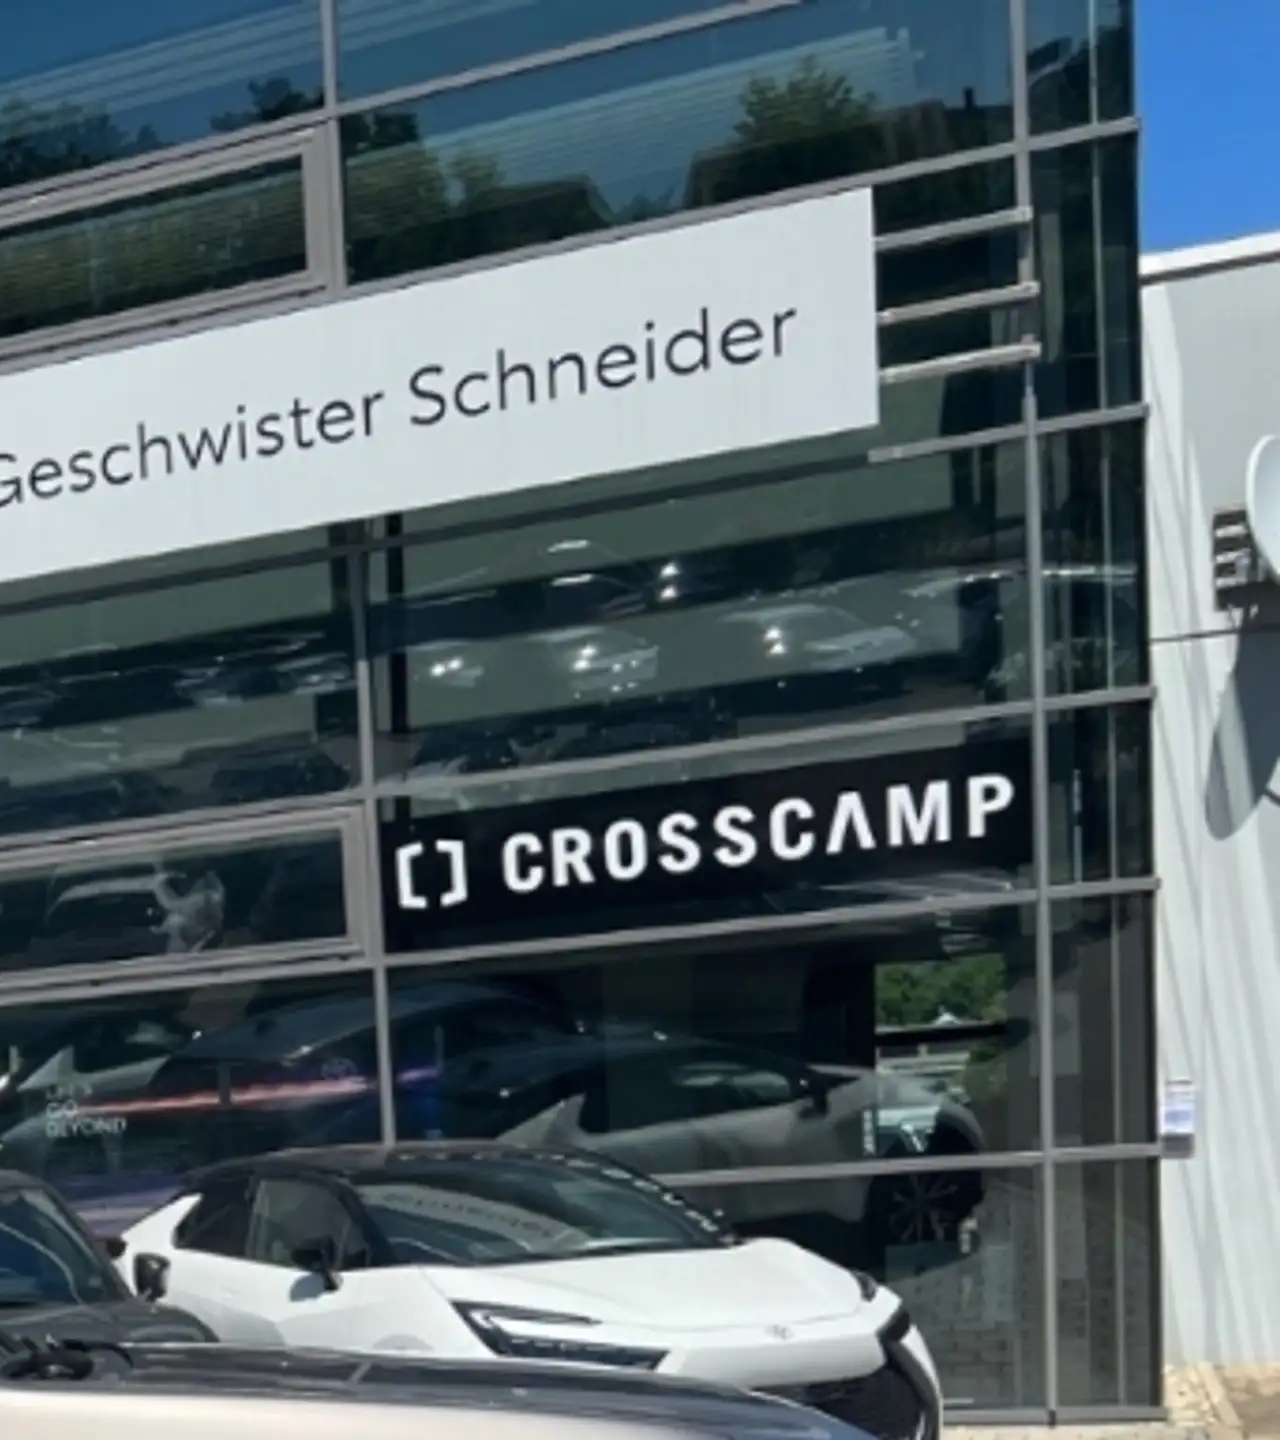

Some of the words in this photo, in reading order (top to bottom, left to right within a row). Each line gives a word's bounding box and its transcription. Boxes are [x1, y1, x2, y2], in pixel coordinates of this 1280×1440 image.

[408, 306, 798, 428] Schneider
[502, 774, 1015, 892] CROSSCAMP
[45, 1082, 93, 1100] LETS
